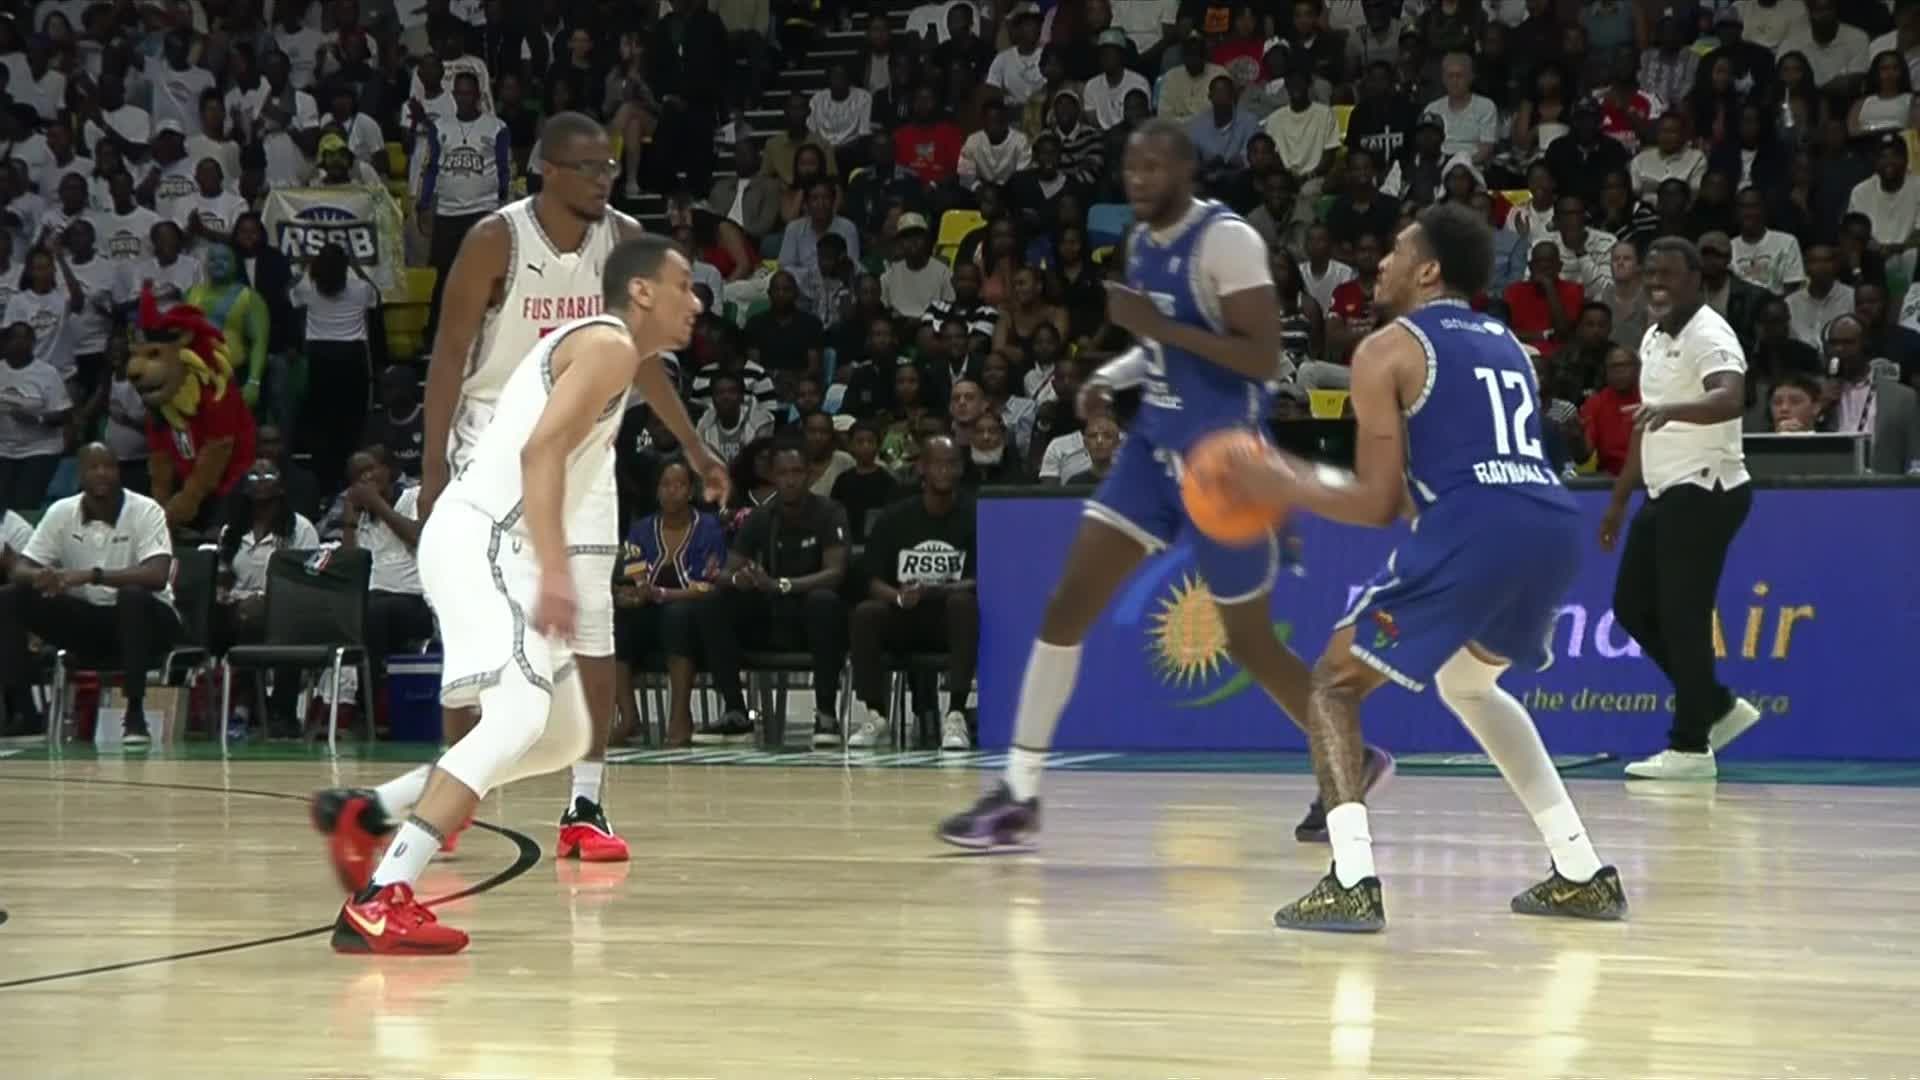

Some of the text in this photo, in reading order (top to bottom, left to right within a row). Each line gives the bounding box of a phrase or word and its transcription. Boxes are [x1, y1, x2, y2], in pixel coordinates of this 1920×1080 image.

[281, 225, 375, 258] RSSB
[523, 297, 552, 320] FUS
[1474, 367, 1543, 460] 12
[902, 554, 963, 575] RSSB
[1571, 687, 1657, 712] dream
